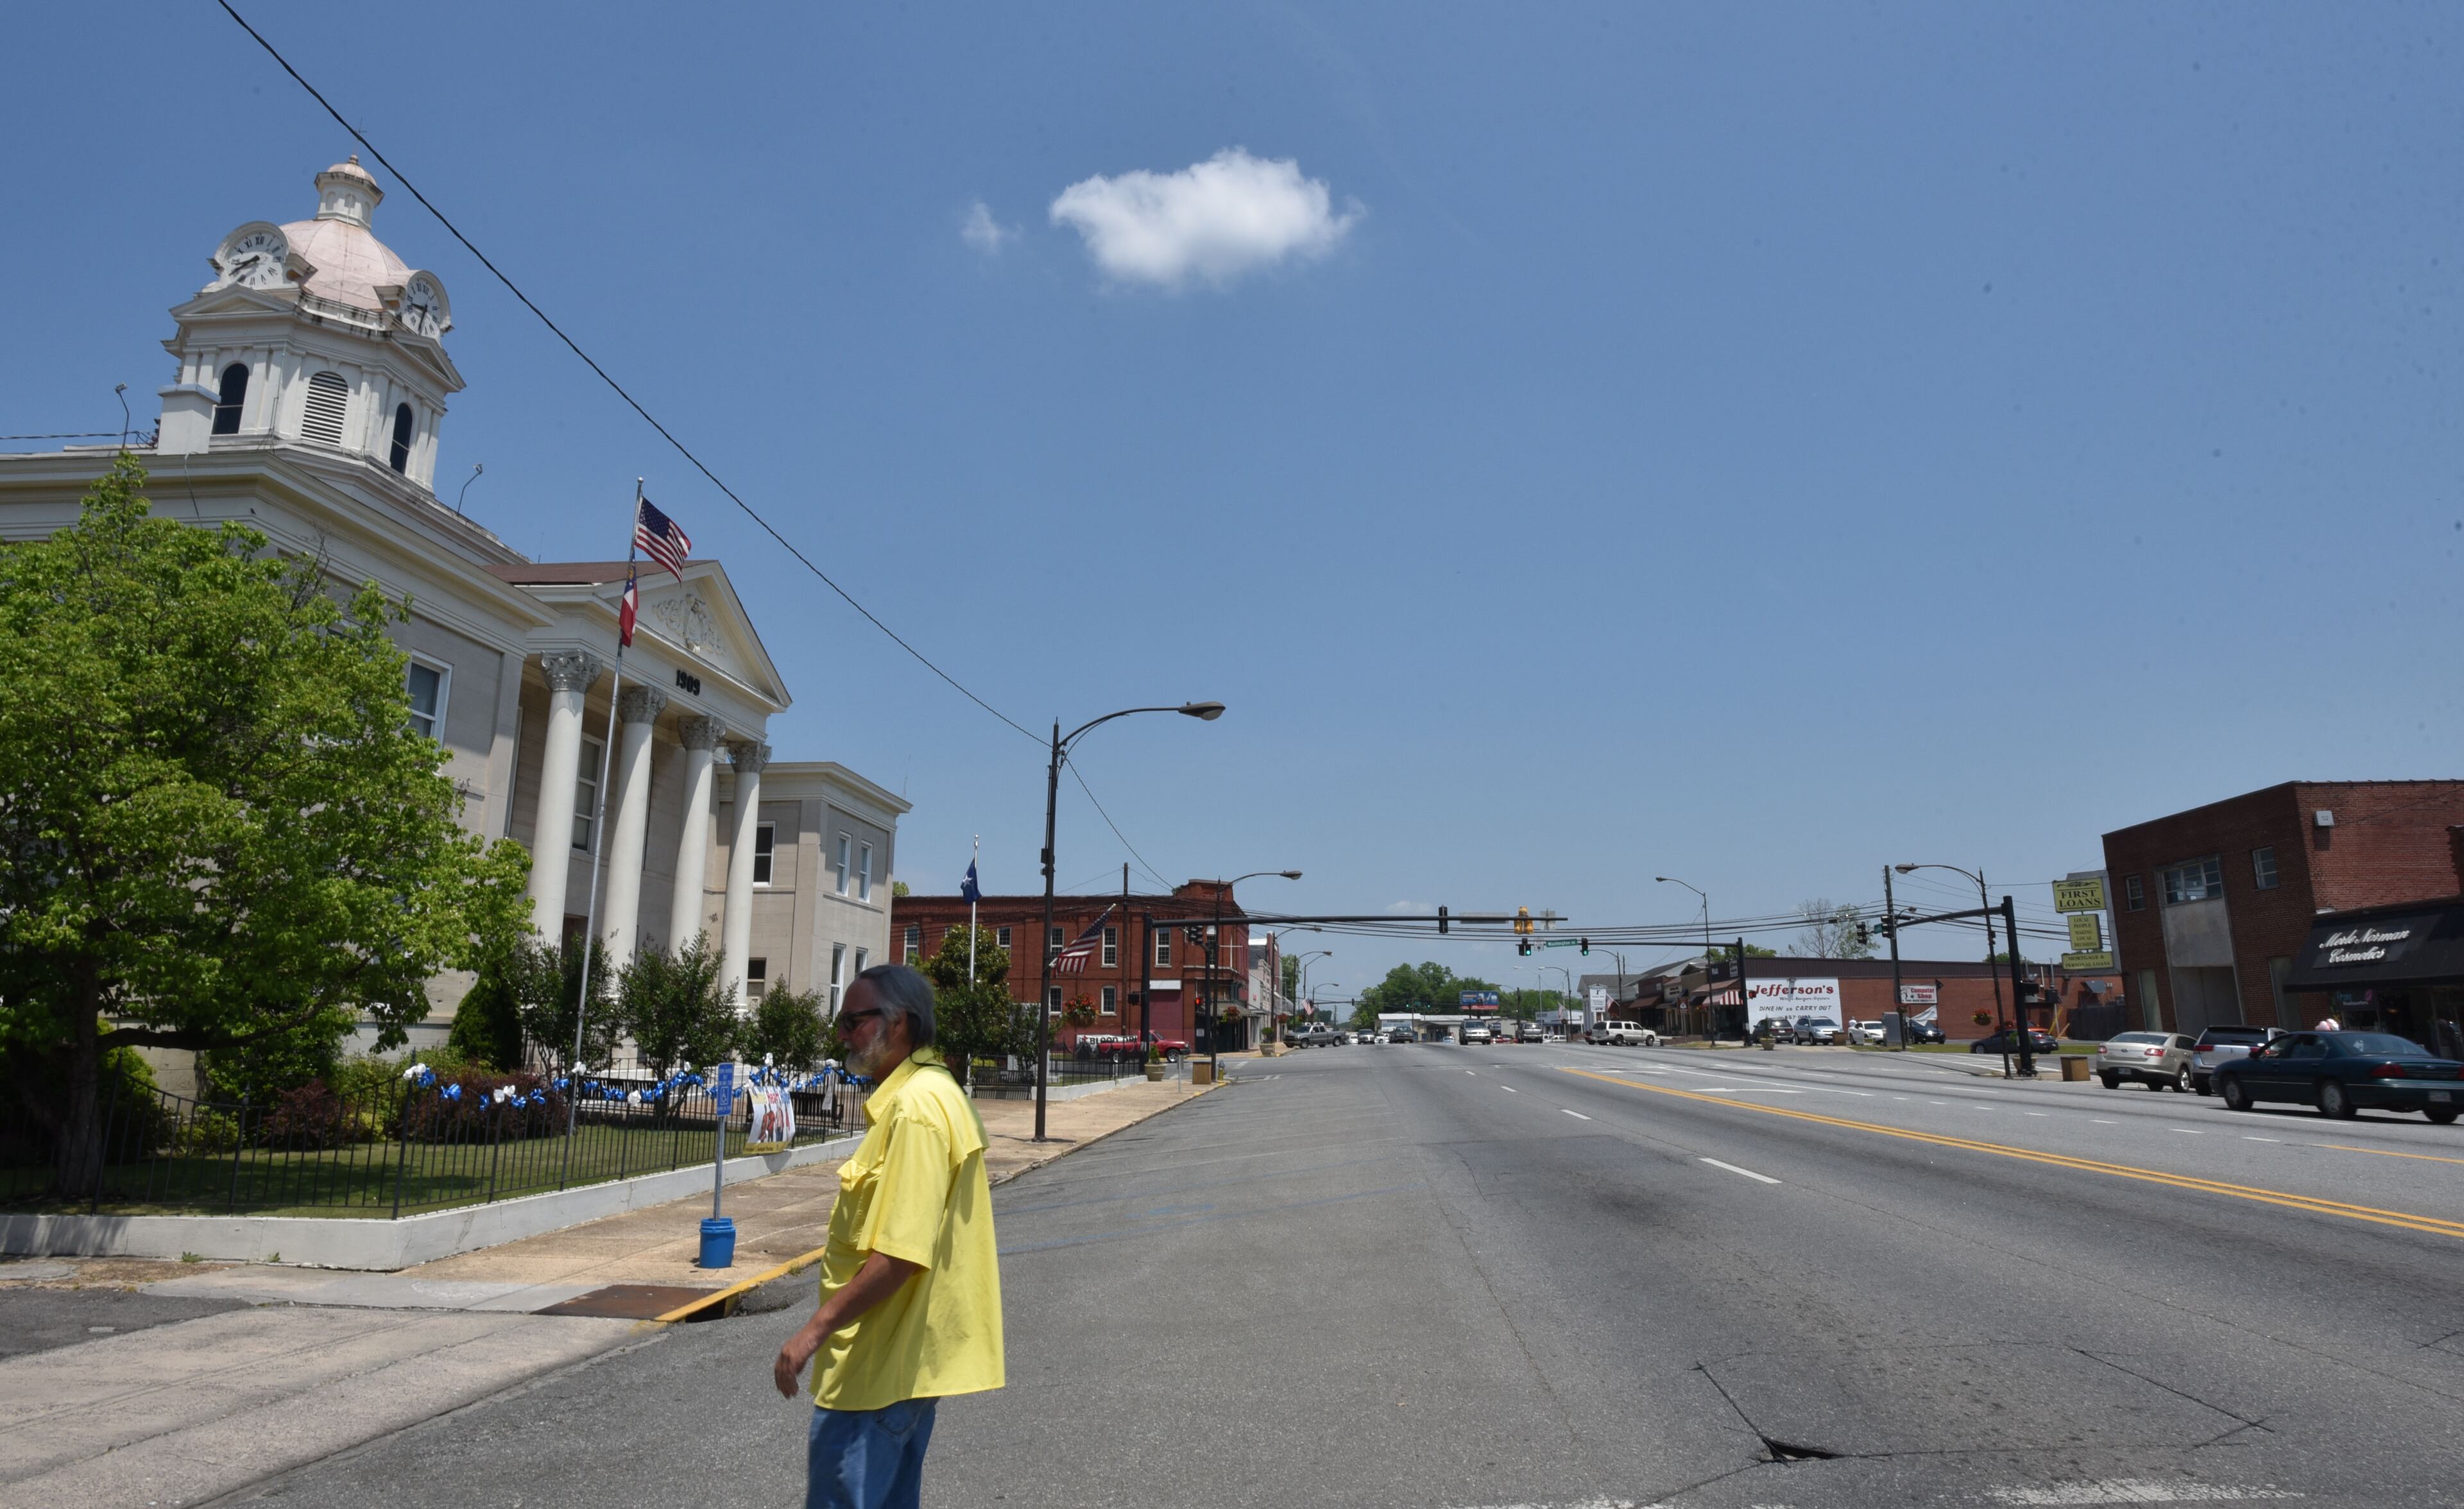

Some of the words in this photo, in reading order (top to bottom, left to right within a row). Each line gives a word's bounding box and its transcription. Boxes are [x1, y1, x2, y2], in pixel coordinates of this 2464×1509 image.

[676, 669, 701, 696] 1909
[2061, 890, 2096, 898] FIRST
[2059, 898, 2101, 907] LOANS
[2354, 928, 2410, 943] Norman
[2329, 946, 2386, 963] Cosmetics
[1755, 984, 1834, 997] Jefferson's
